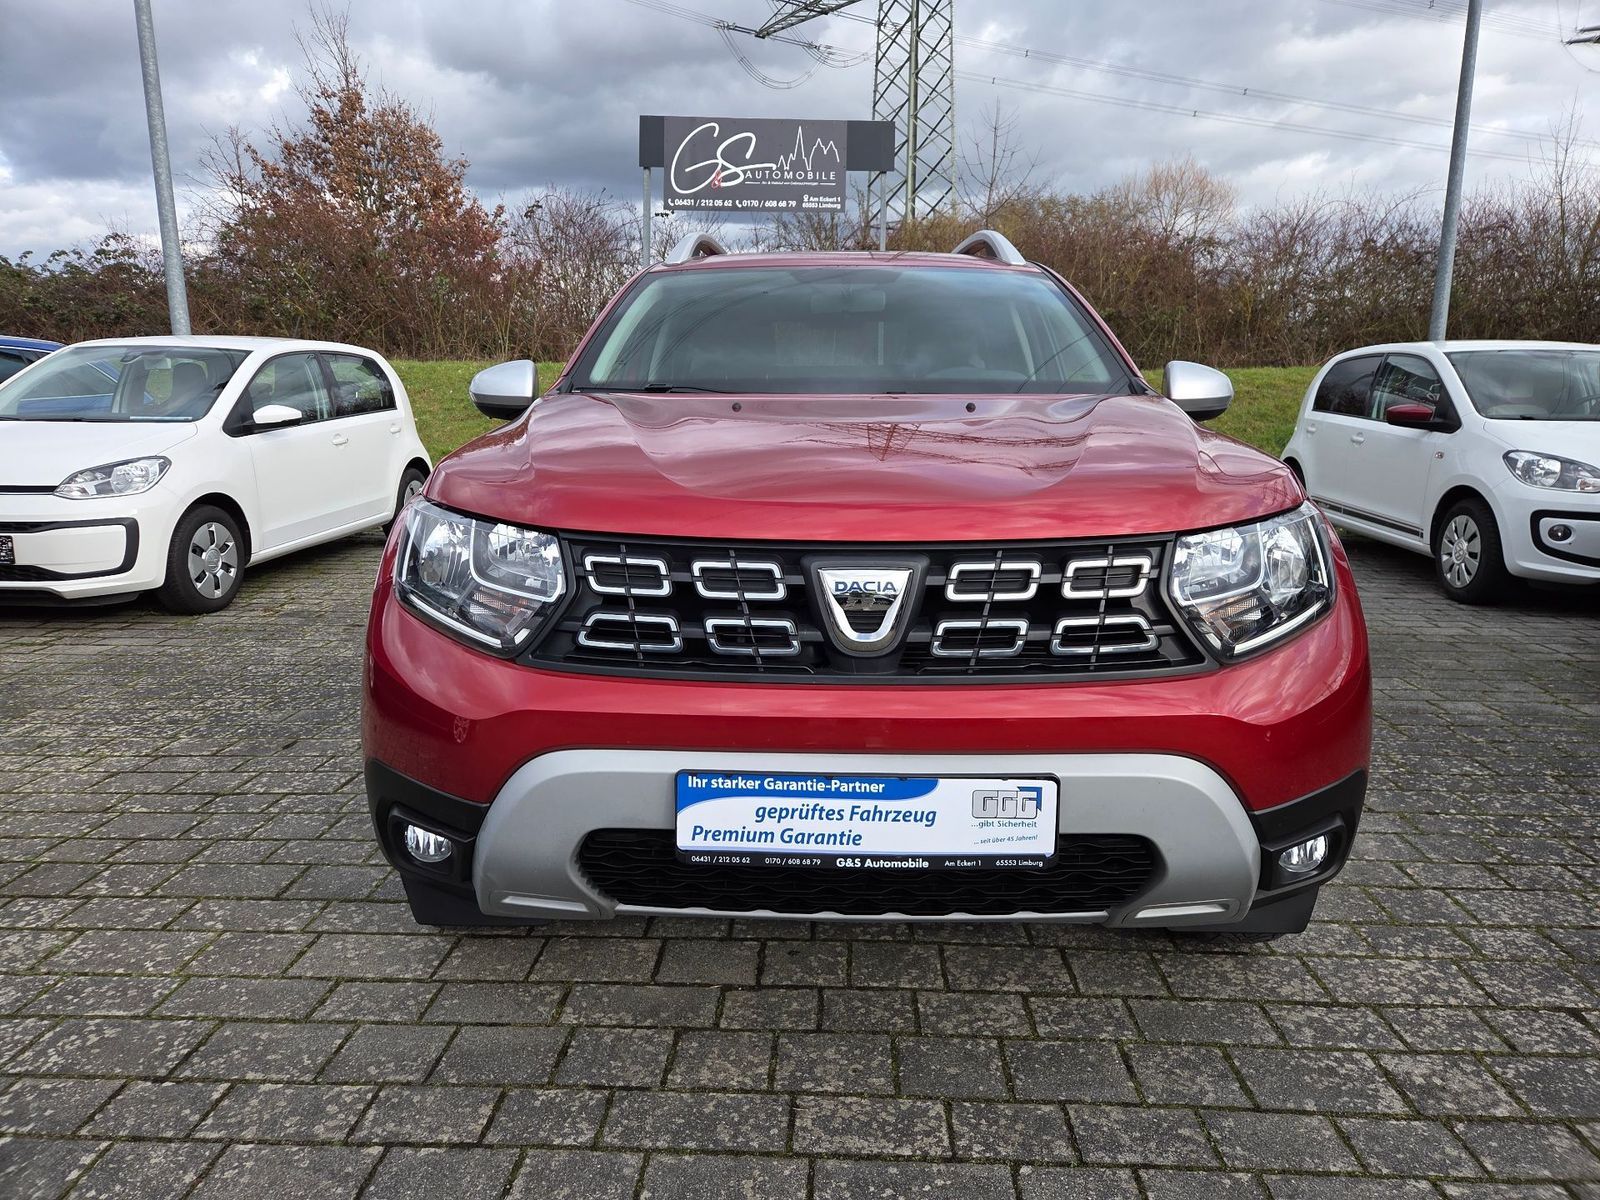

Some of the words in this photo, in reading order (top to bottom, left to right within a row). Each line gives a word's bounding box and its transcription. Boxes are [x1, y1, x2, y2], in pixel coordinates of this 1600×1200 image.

[745, 170, 836, 180] AUTOMOBILE
[674, 198, 695, 206] 06431
[700, 199, 713, 207] 212
[714, 199, 723, 207] 05
[724, 199, 733, 207] 62
[742, 199, 759, 207] 0170
[764, 200, 777, 208] 608
[778, 200, 787, 208] 68
[788, 200, 797, 208] 79
[834, 581, 897, 593] DACIA
[688, 775, 708, 788] Ihr
[711, 776, 761, 790] starker
[764, 778, 885, 793] Garantie-Partner
[755, 803, 845, 823] geprüftes
[850, 805, 937, 827] Fahrzeug
[691, 825, 775, 843] Premium
[780, 828, 863, 846] Garantie
[992, 836, 1006, 844] über
[812, 858, 820, 866] 79
[836, 858, 861, 867] G&S
[864, 858, 929, 868] Automobile
[1018, 859, 1043, 868] Limburg
